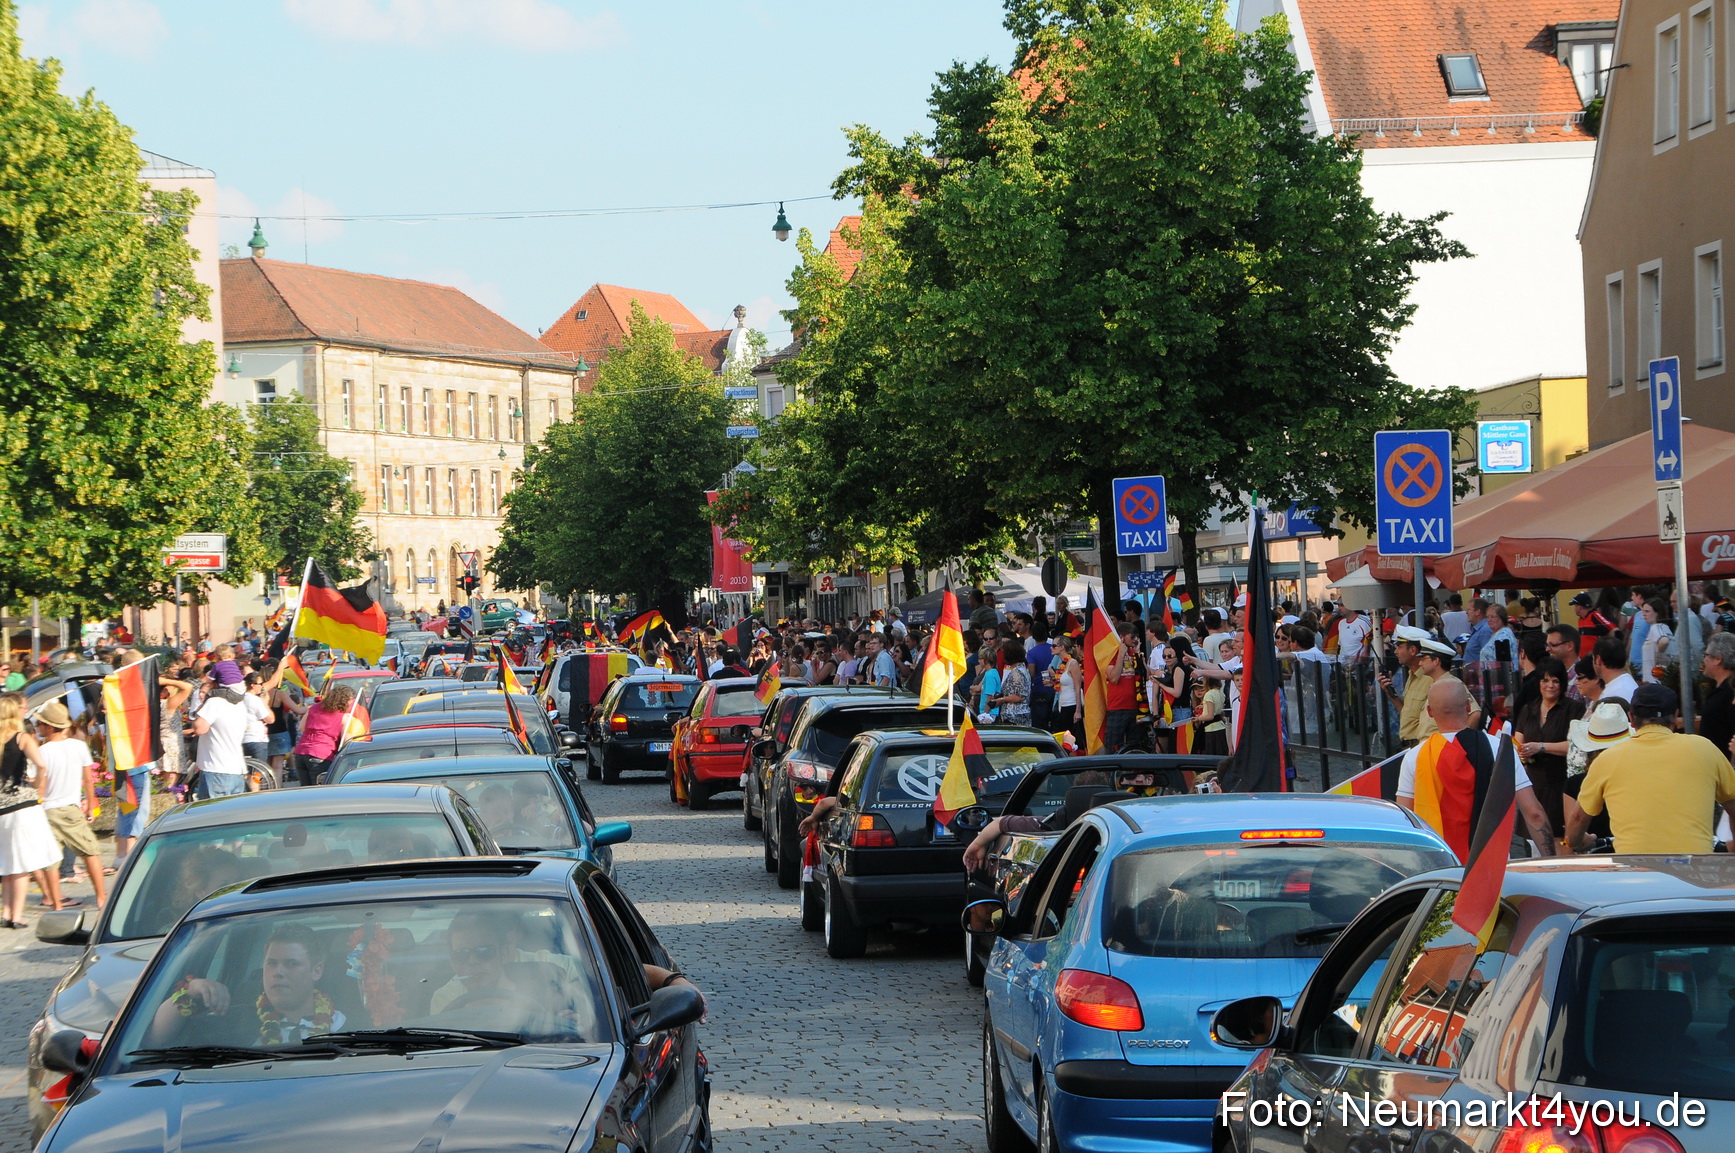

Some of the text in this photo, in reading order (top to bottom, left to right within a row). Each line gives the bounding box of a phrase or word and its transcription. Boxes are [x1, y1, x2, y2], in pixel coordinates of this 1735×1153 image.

[1655, 372, 1673, 440] P
[1122, 530, 1162, 548] TAXI
[1384, 518, 1444, 543] TAXI
[175, 540, 208, 550] tsystem
[1702, 534, 1735, 573] Glo
[730, 576, 748, 584] 2010
[1128, 1040, 1190, 1048] PEUGEOT
